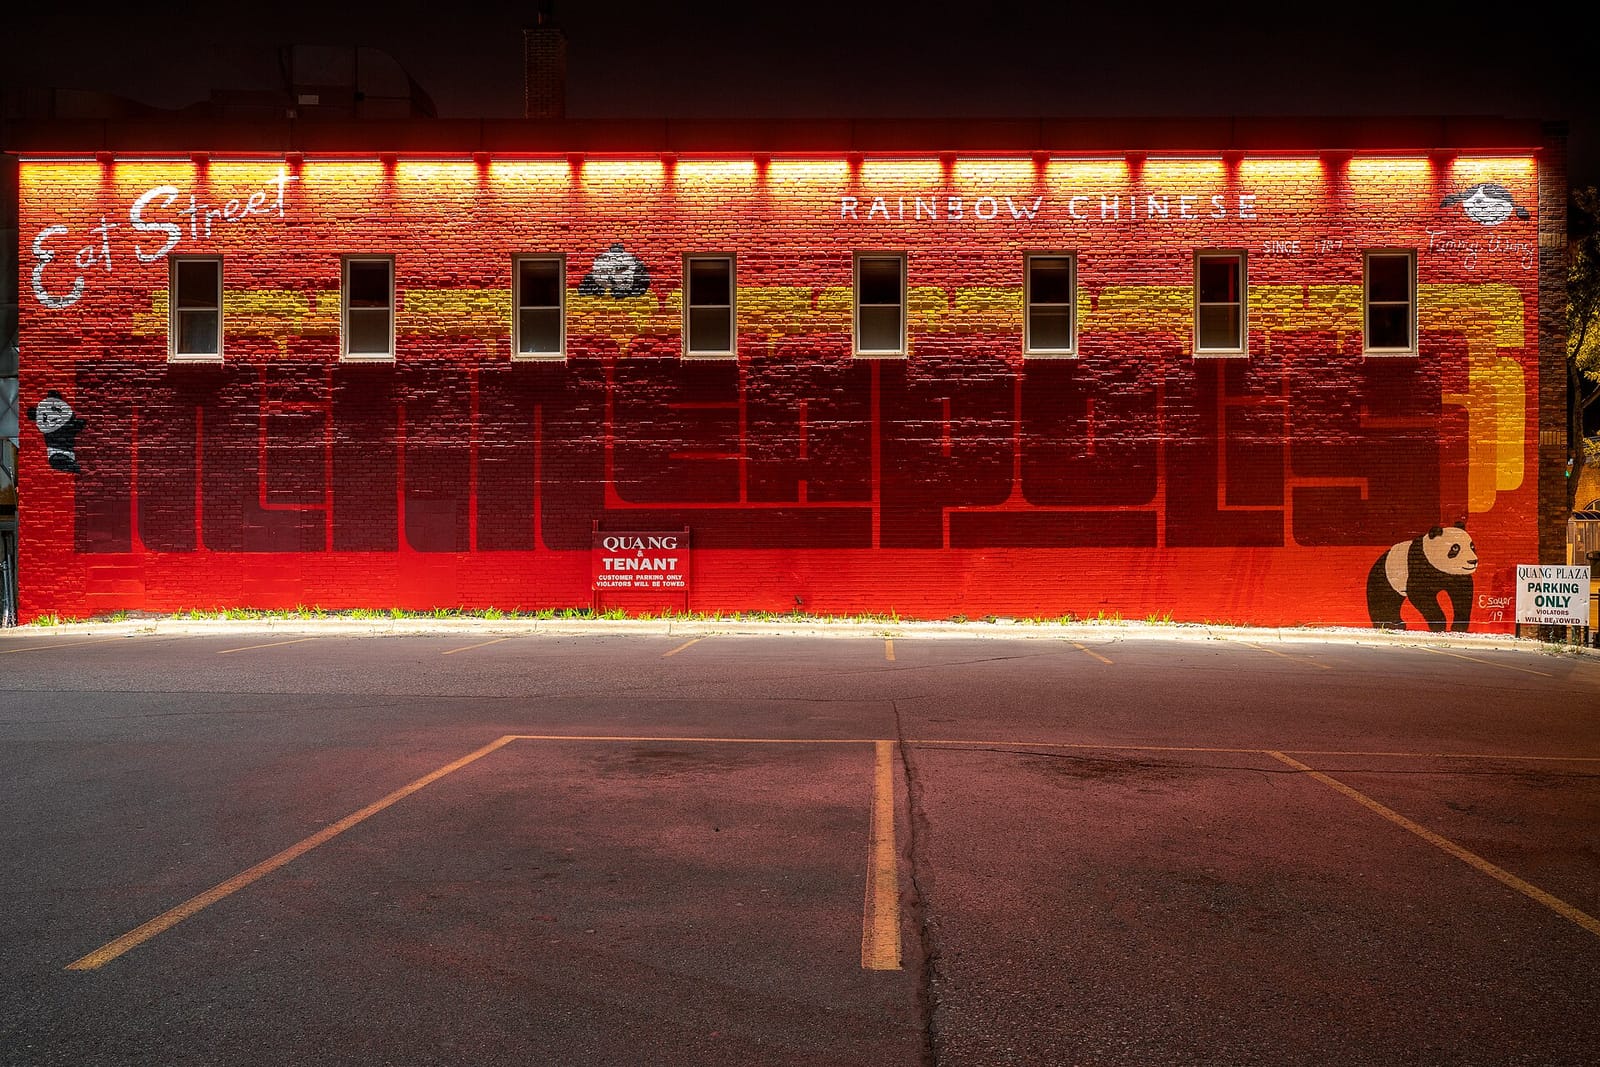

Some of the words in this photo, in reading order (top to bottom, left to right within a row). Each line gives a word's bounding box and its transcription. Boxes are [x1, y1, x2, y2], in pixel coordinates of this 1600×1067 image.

[840, 195, 1041, 220] RAINBOW
[1068, 194, 1259, 220] CHINESE
[32, 213, 120, 309] Eat
[129, 166, 299, 263] Street
[1262, 240, 1301, 254] SINCE
[603, 536, 678, 552] QUANG
[636, 550, 644, 558] &
[602, 558, 678, 571] TENANT
[1518, 567, 1552, 580] QUANG
[1556, 567, 1589, 580] PLAZA
[1527, 582, 1579, 594] PARKING
[1534, 595, 1571, 608] ONLY
